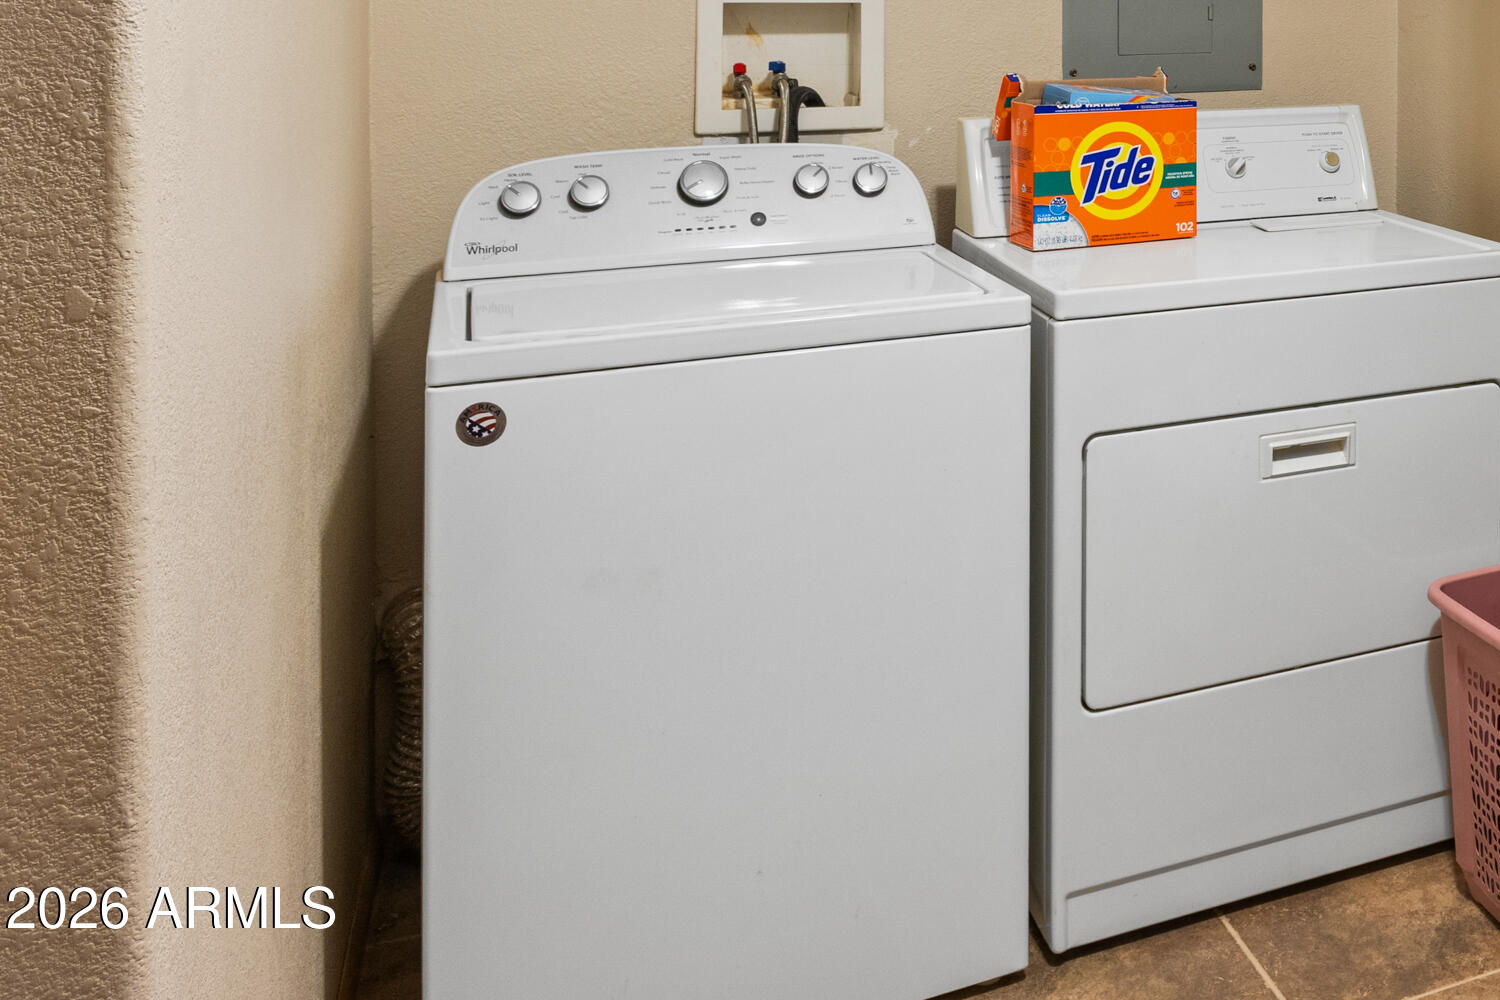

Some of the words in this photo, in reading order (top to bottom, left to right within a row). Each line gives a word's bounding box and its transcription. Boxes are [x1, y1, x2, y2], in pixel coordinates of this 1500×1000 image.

[1079, 144, 1157, 208] Tide
[1175, 221, 1194, 232] 102
[465, 243, 518, 256] Whirlpool
